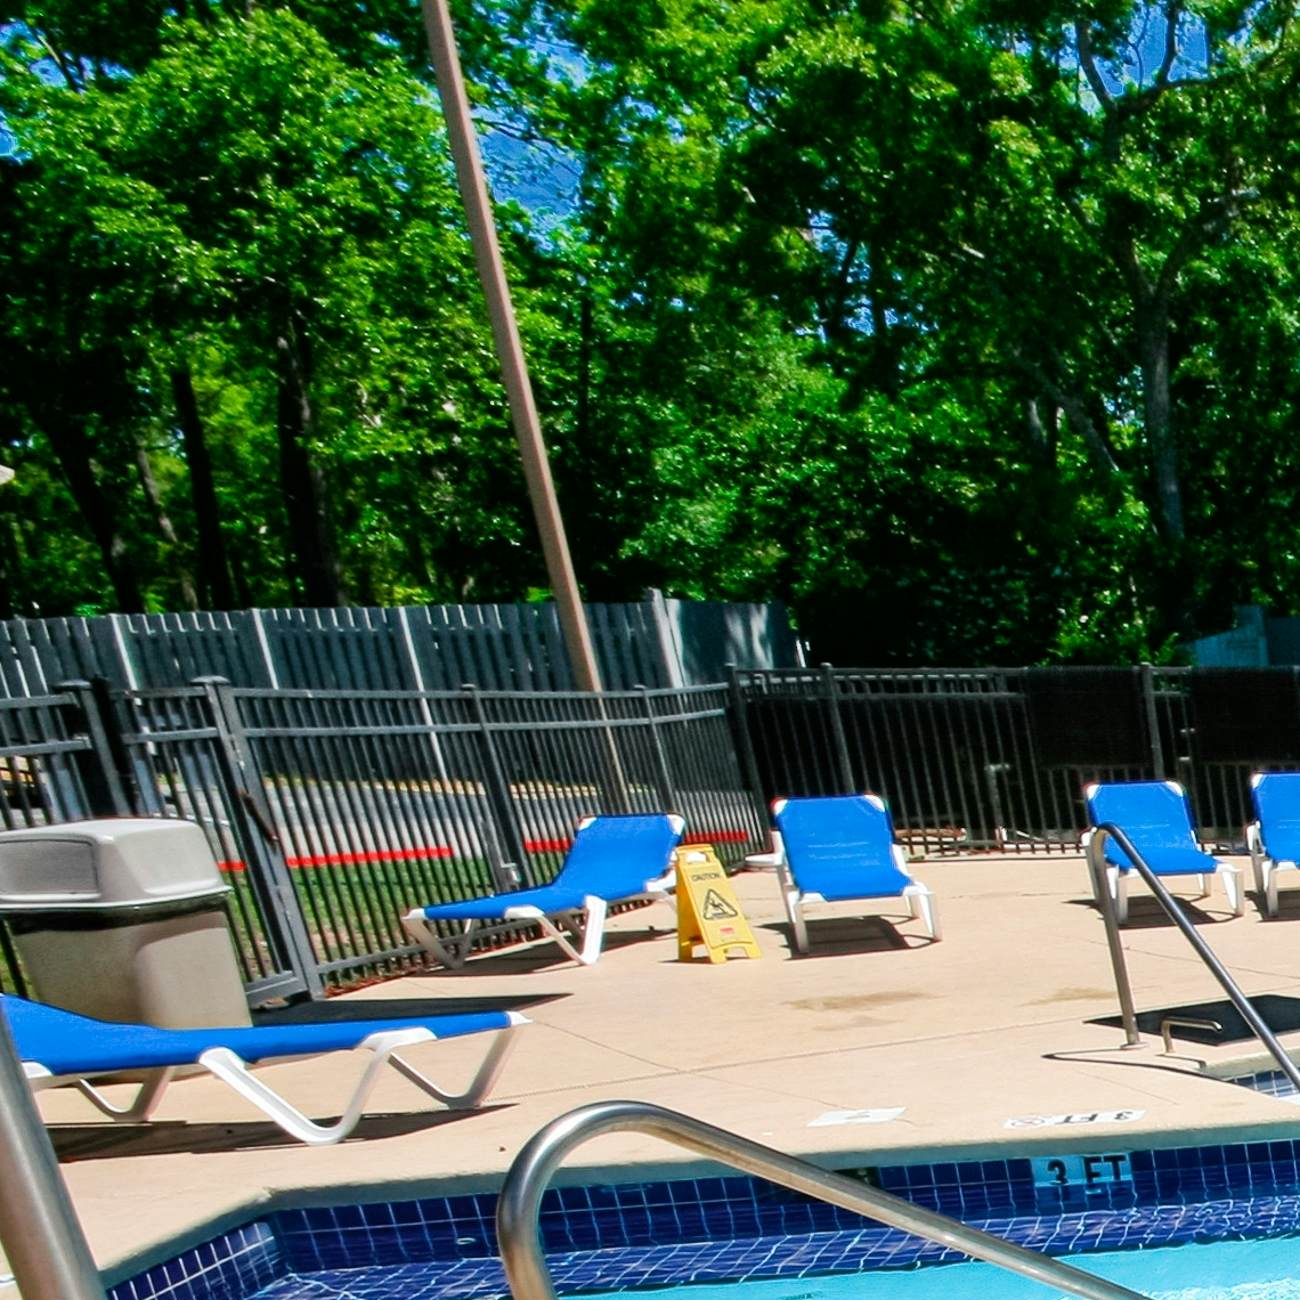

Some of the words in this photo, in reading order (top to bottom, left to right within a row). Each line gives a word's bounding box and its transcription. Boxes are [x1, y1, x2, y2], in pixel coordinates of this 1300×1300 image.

[691, 873, 721, 882] CAUTION
[1047, 1159, 1068, 1186] 3
[1084, 1154, 1127, 1187] FT
